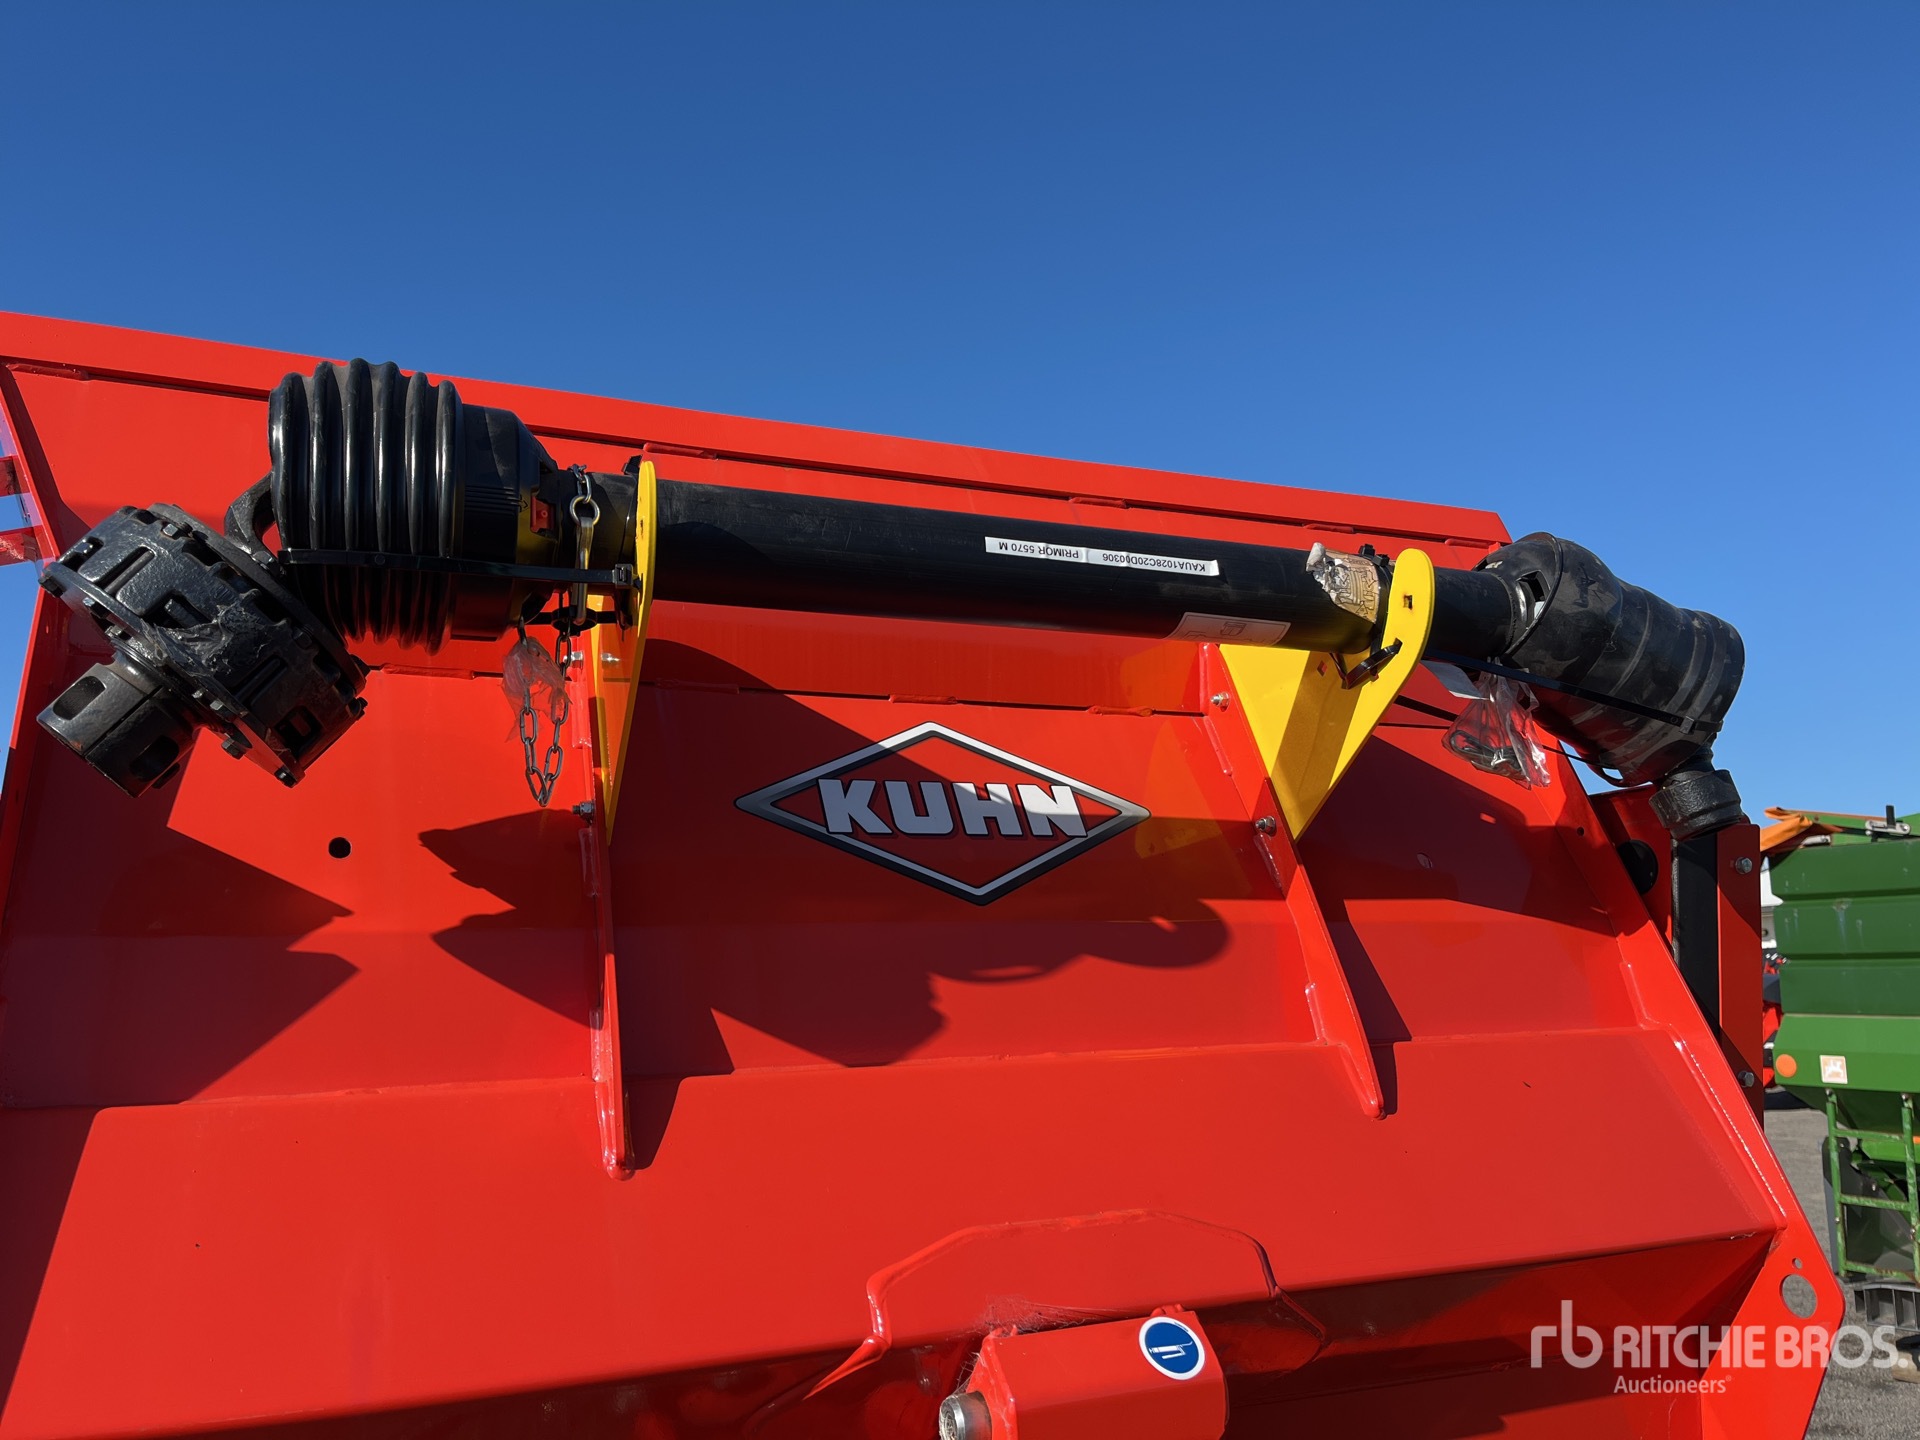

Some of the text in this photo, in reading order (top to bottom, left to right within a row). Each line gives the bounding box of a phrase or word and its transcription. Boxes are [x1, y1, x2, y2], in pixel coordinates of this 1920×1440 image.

[998, 541, 1079, 559] PRIMOR 5570 M
[818, 779, 1087, 837] KUHN
